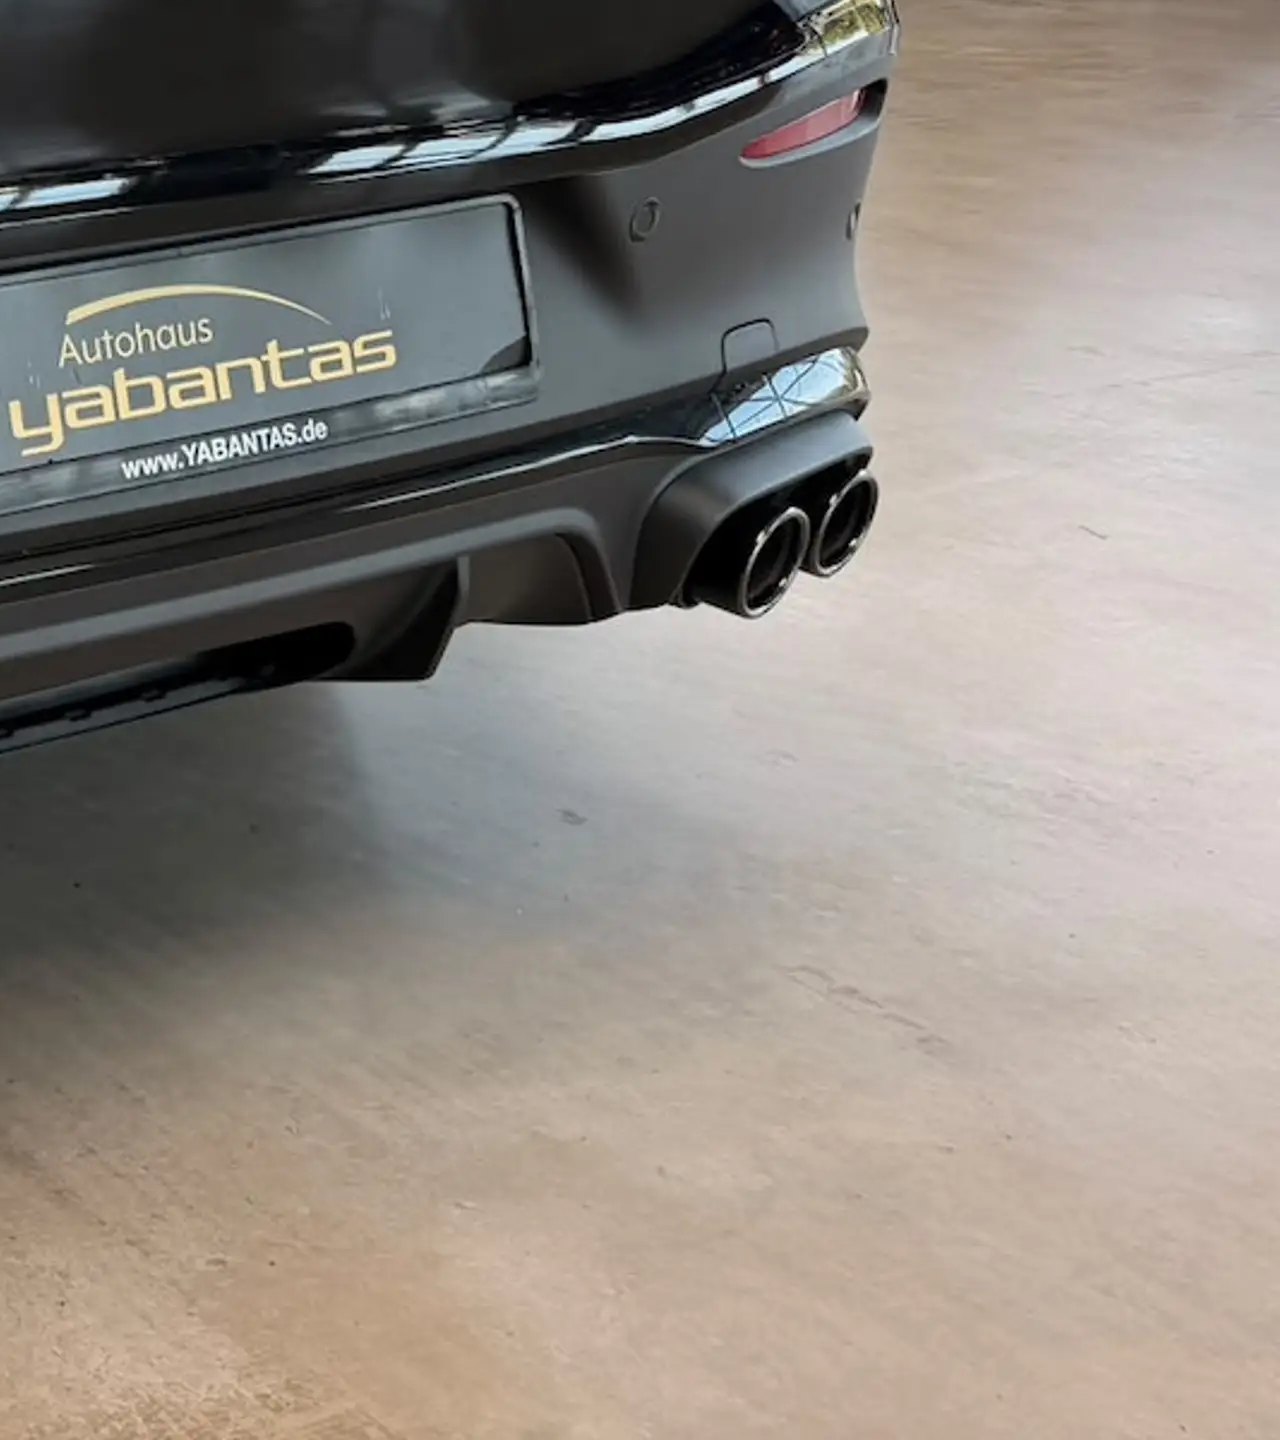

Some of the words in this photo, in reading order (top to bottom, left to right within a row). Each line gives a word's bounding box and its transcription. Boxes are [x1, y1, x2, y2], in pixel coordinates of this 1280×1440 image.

[58, 316, 214, 368] Autohaus
[8, 329, 398, 457] yabantas
[121, 417, 329, 480] www.YABANTAS.de
